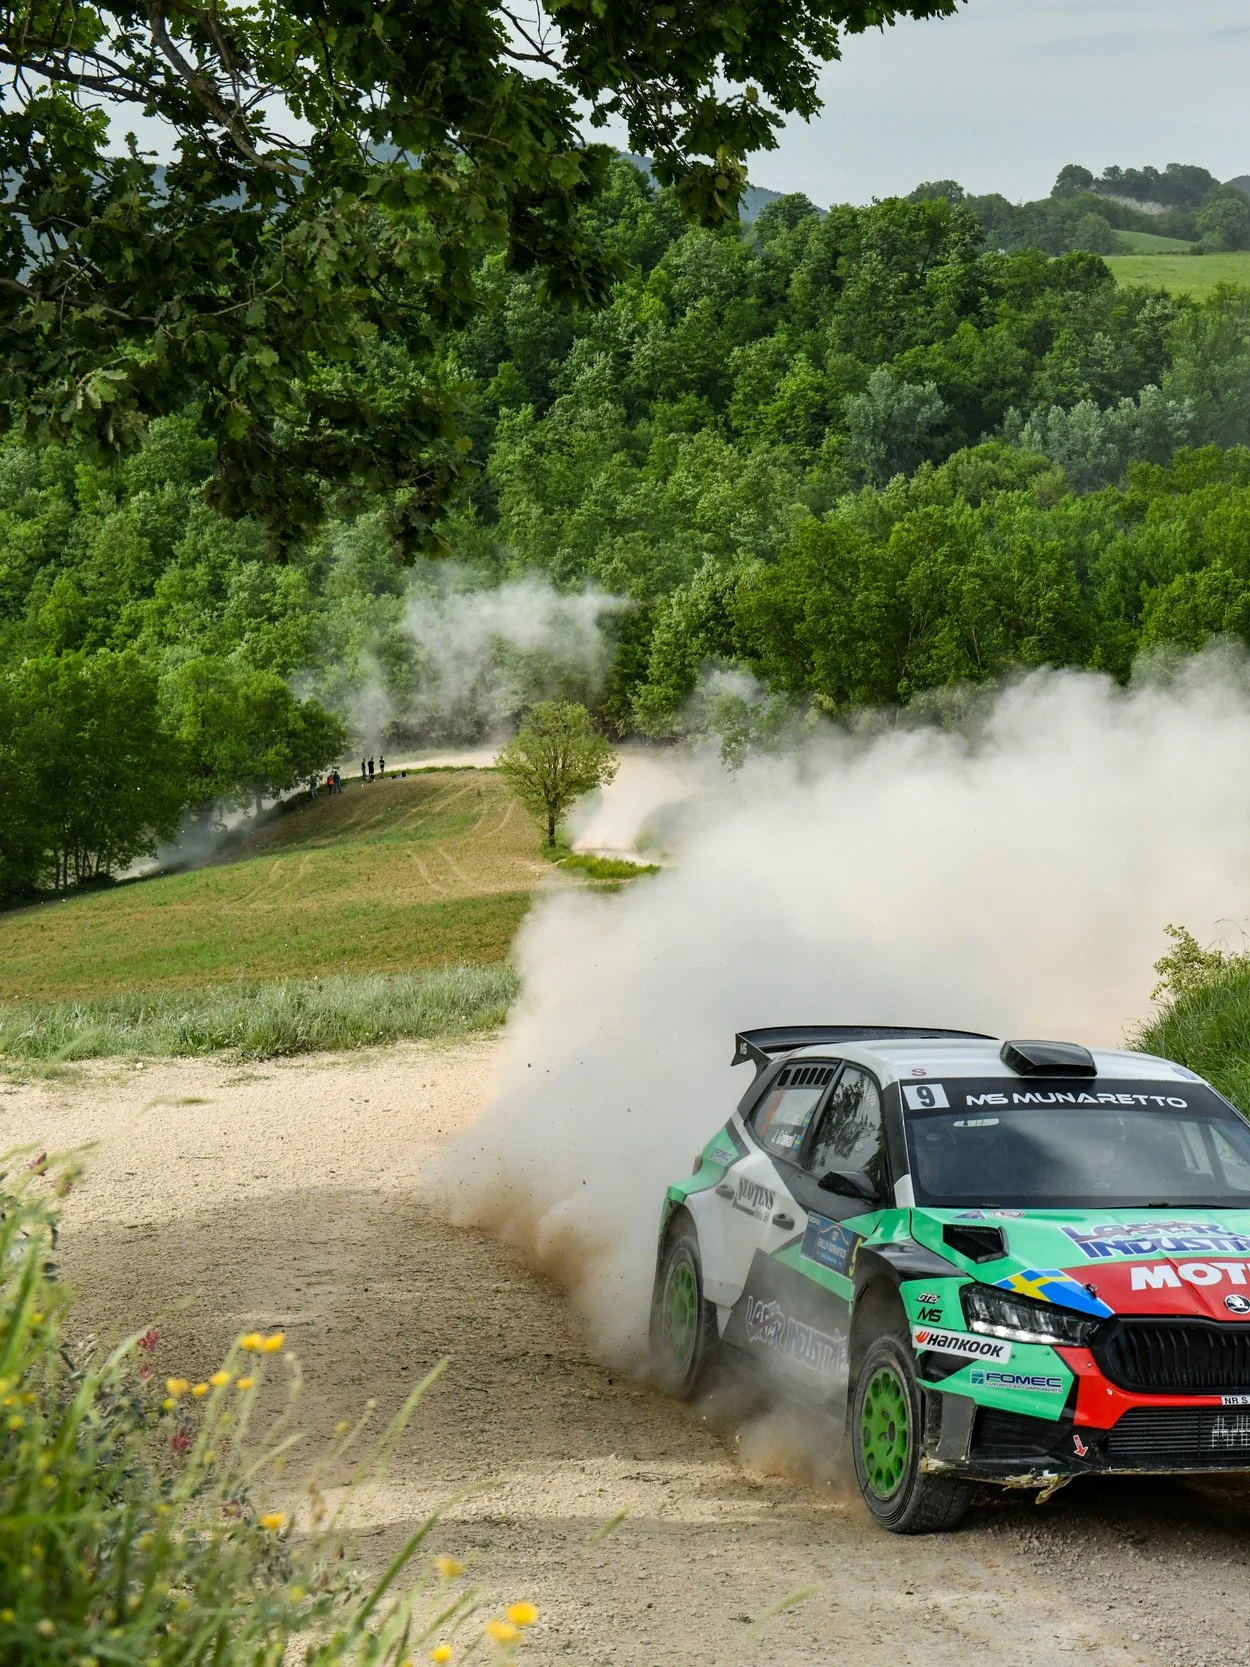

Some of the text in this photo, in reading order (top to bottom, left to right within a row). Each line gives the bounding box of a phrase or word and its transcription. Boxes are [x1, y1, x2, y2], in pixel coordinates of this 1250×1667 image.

[916, 1086, 936, 1108] 9
[966, 1091, 1189, 1109] MS MUNARETTO
[917, 1307, 944, 1323] MS
[926, 1333, 1005, 1358] HanKOOK
[986, 1372, 1062, 1388] FOMEC
[1224, 1396, 1239, 1405] NR
[1241, 1396, 1248, 1404] S
